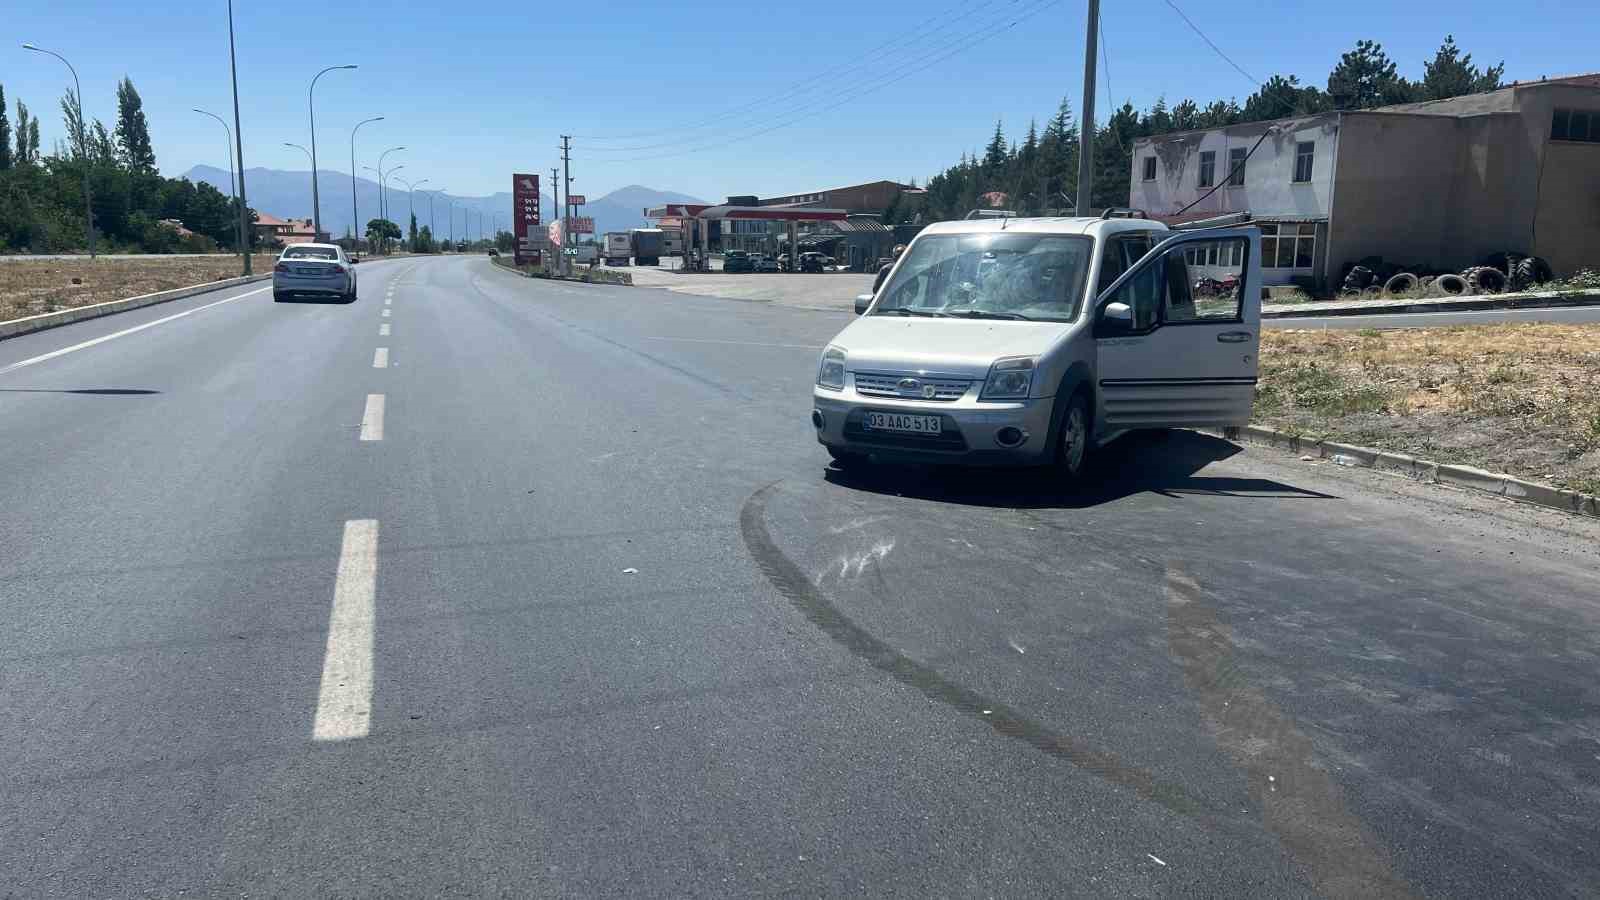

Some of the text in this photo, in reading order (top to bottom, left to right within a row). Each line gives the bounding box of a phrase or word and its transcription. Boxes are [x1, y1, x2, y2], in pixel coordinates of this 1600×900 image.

[871, 414, 938, 431] 03 AAC 513
